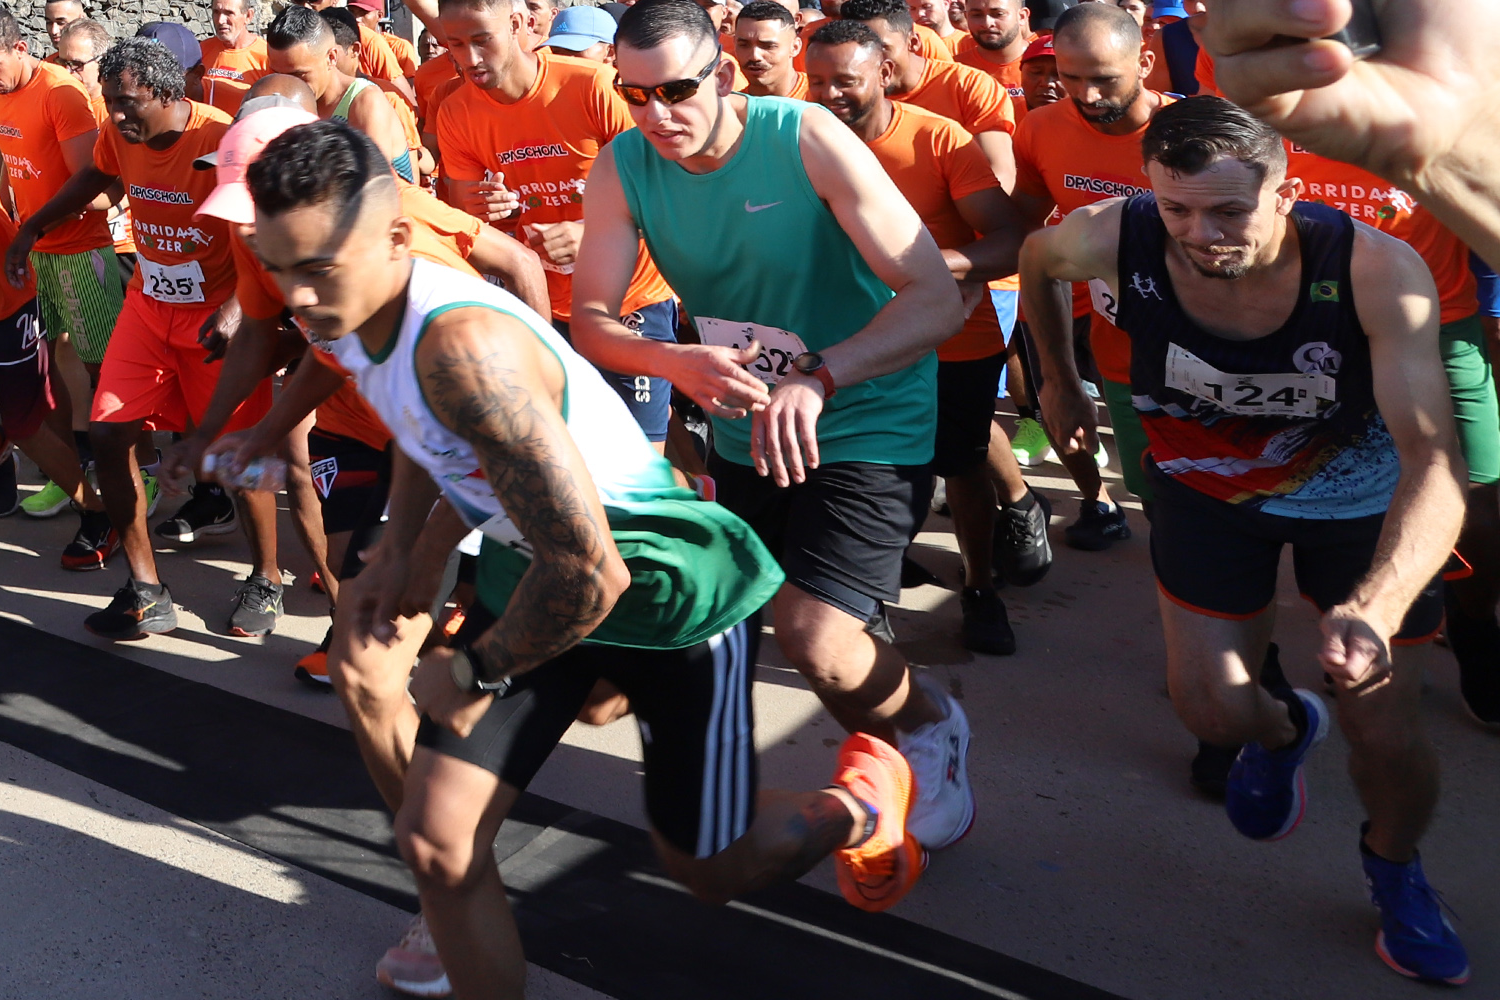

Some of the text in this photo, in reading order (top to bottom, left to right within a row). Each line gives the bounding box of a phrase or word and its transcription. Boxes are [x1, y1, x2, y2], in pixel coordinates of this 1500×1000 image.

[129, 183, 194, 204] DPASCHOAL
[150, 275, 193, 296] 235
[1203, 382, 1300, 407] 124
